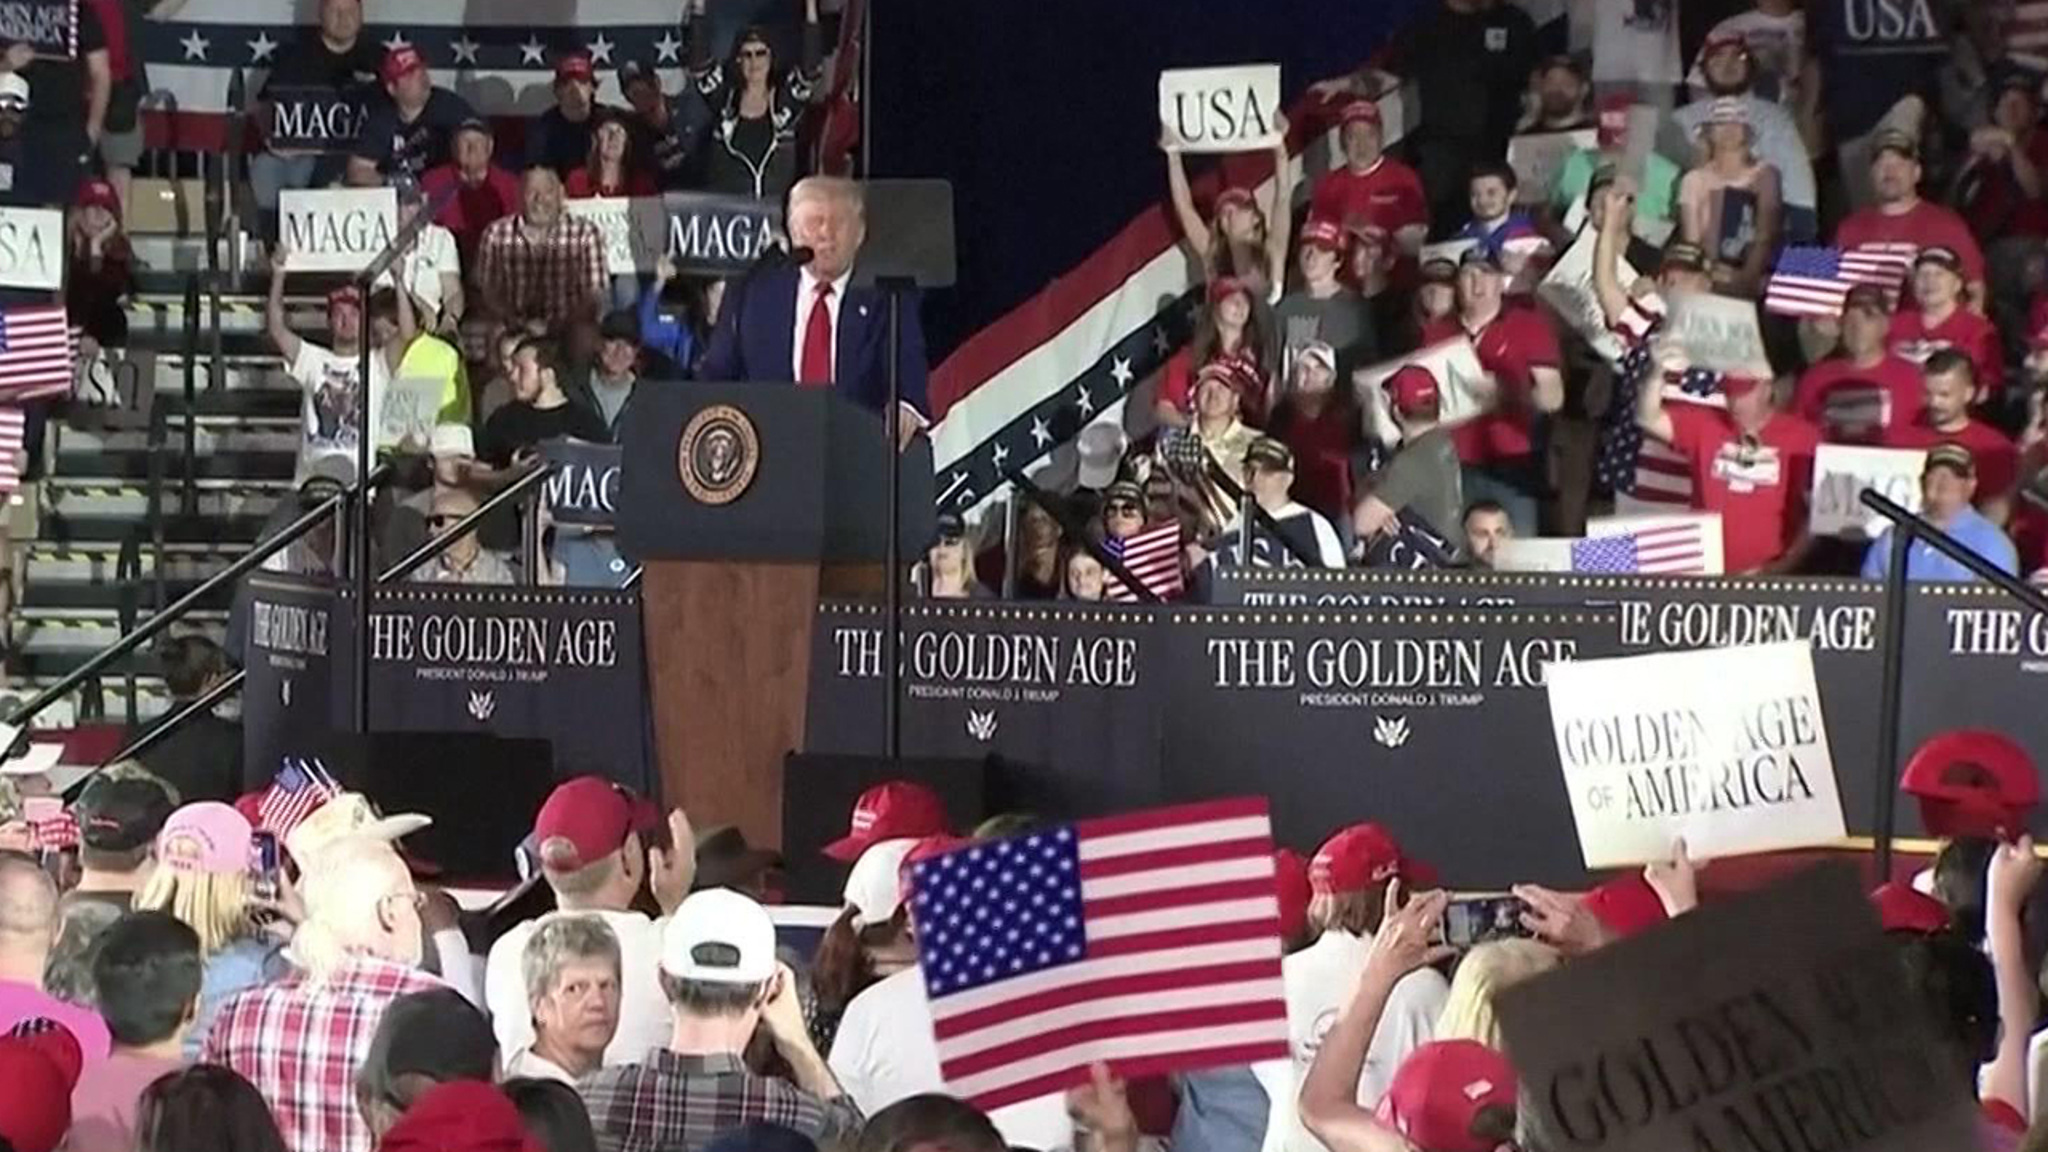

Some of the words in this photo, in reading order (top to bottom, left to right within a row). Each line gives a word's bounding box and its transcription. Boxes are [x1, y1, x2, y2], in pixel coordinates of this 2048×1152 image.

[1844, 0, 1940, 39] USA
[273, 101, 369, 138] MAGA
[1175, 84, 1268, 142] USA
[0, 221, 47, 276] SA
[286, 210, 391, 253] MAGA
[666, 213, 774, 259] MAGA
[547, 464, 621, 513] MAG
[421, 614, 547, 664] GOLDEN
[554, 618, 615, 667] AGE
[1659, 601, 1799, 648] GOLDEN
[1810, 605, 1875, 650] AGE
[1947, 608, 2021, 655] THE
[914, 630, 1058, 683] GOLDEN
[1066, 636, 1137, 687] AGE
[1207, 638, 1296, 688] THE
[1306, 638, 1483, 688] GOLDEN
[1300, 693, 1369, 706] PRESIDENT
[1371, 693, 1427, 706] DONALD
[1439, 693, 1484, 707] TRUMP
[1587, 784, 1616, 810] OF
[1625, 752, 1814, 819] AMERICA
